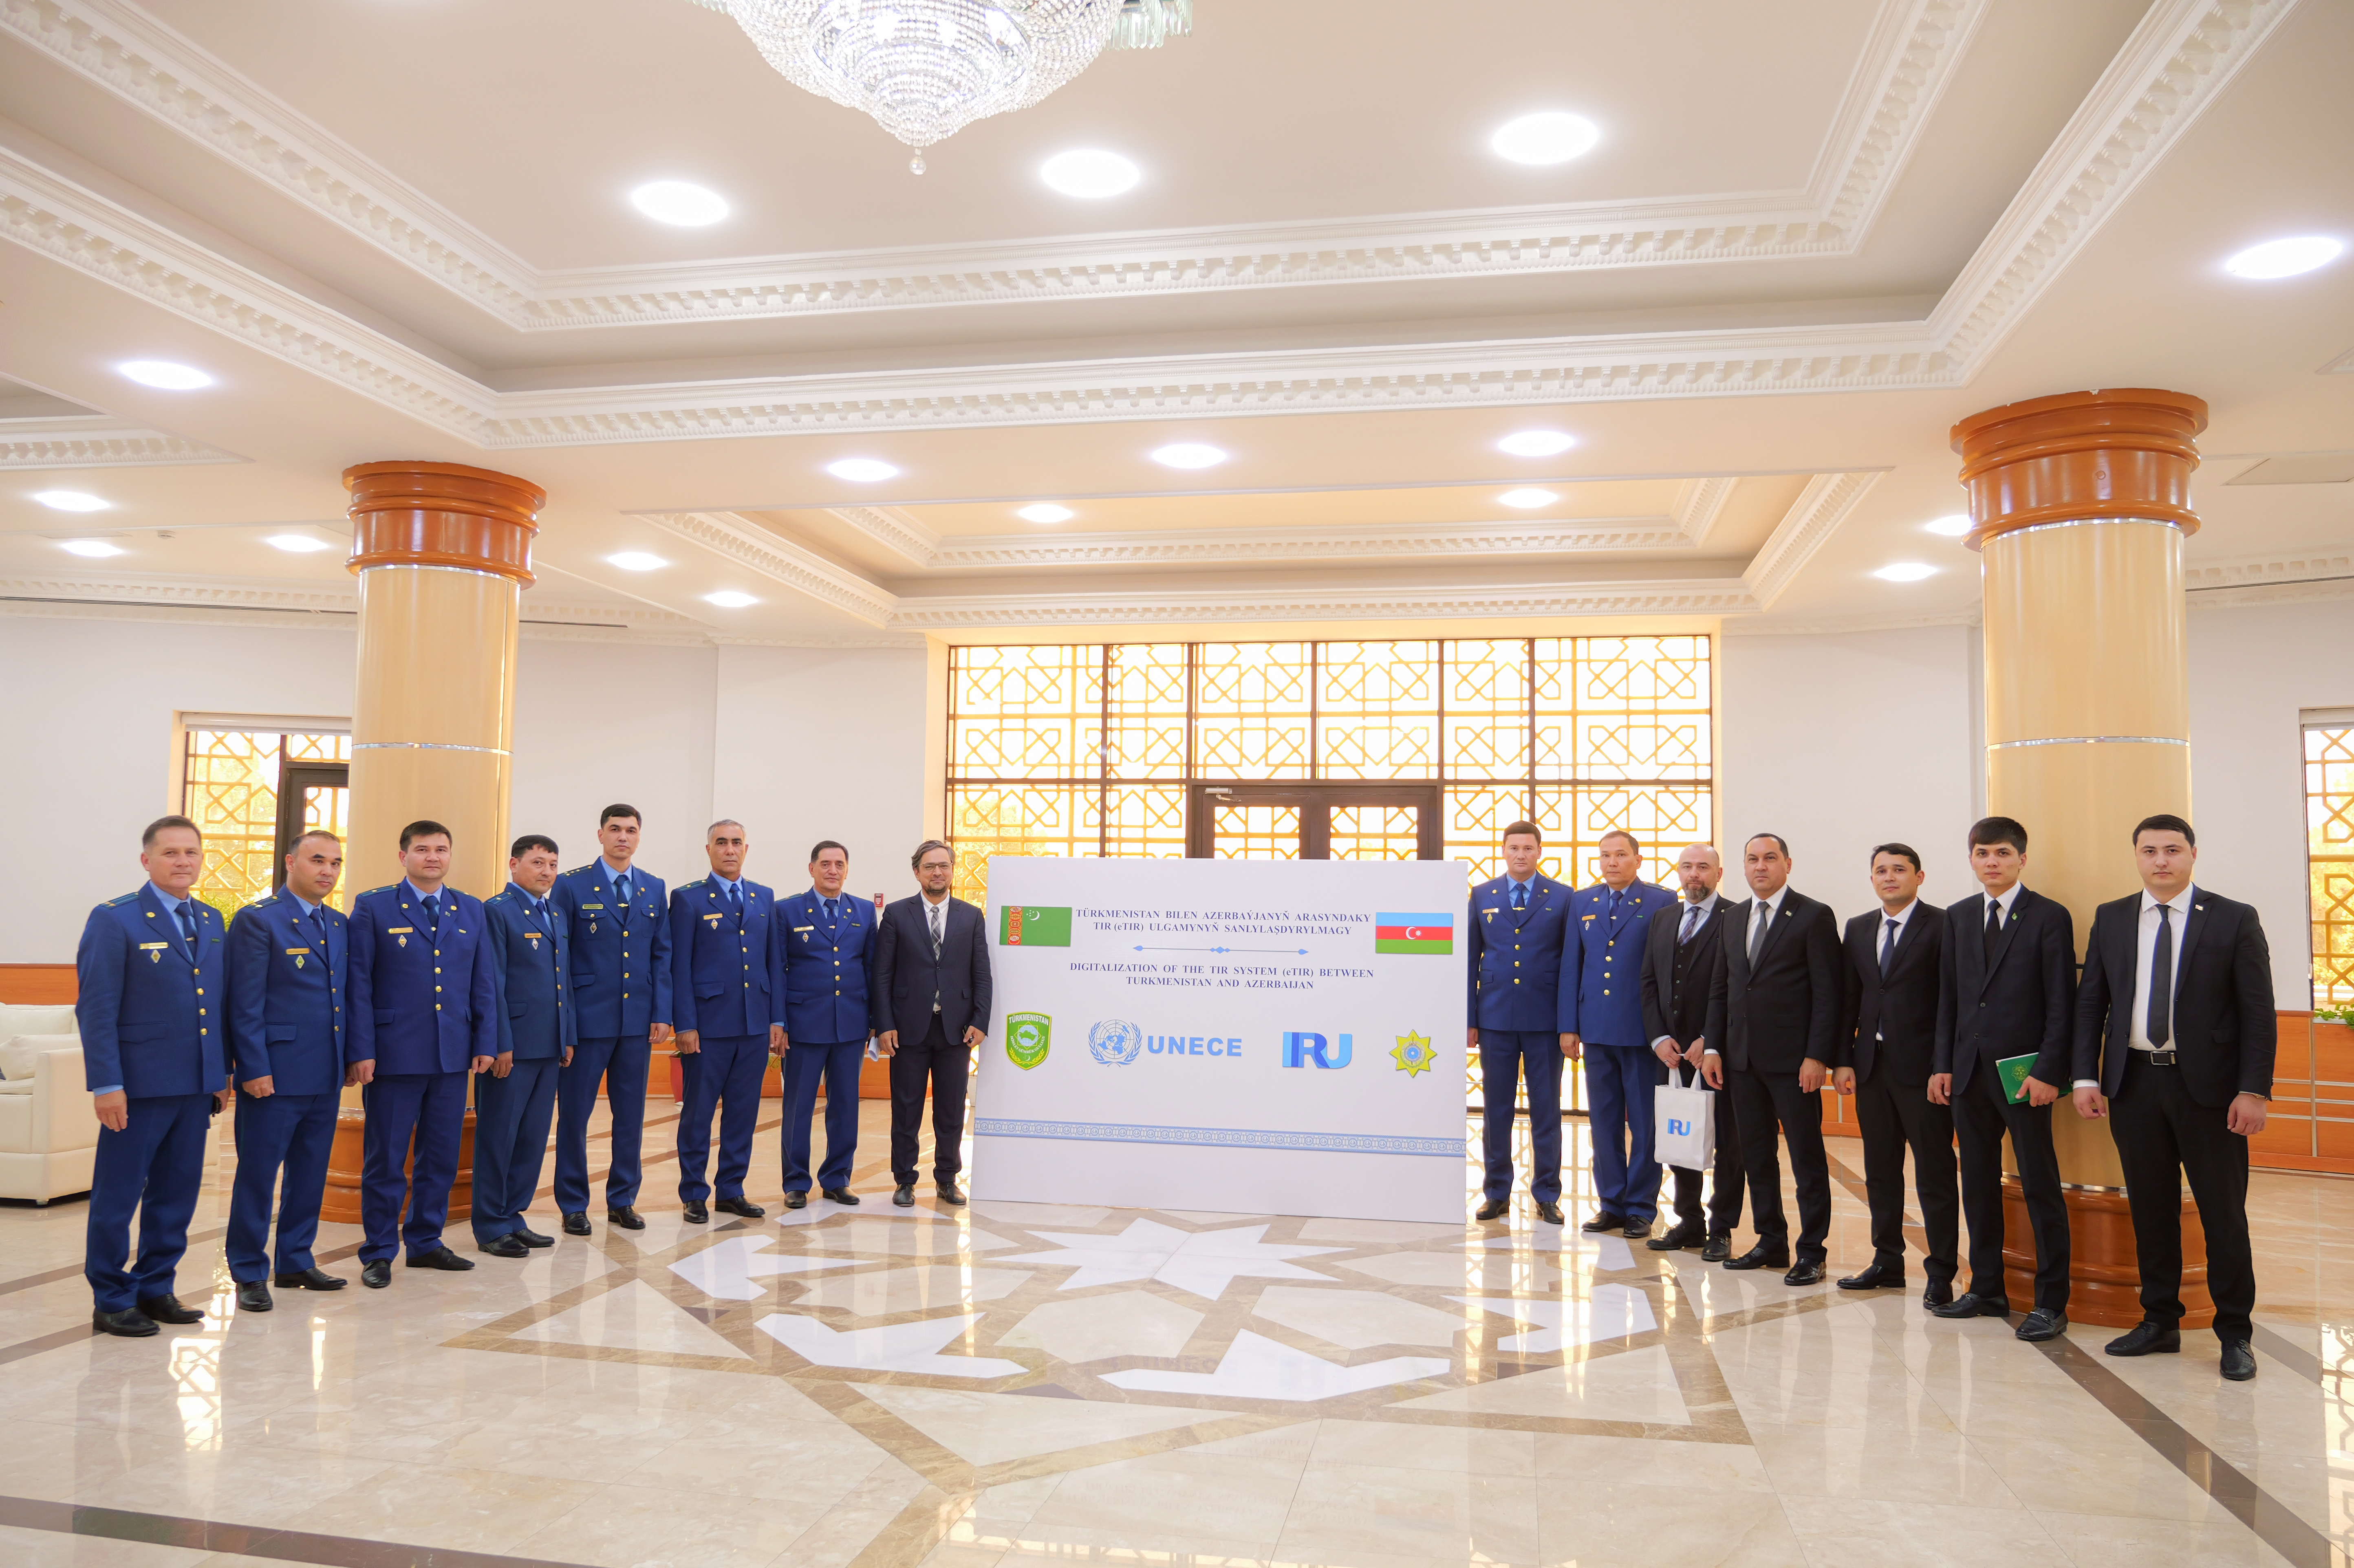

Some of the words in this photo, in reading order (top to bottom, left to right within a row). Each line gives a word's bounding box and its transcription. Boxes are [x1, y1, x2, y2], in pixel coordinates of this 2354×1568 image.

[1076, 907, 1159, 918] TÜRKMENISTAN
[1166, 911, 1197, 919] BILEN
[1202, 910, 1289, 921] AZERBAÝJANYŇ
[1294, 913, 1371, 922] ARASYNDAKY
[1093, 922, 1111, 930] TIR
[1114, 923, 1144, 932] (eTIR)
[1150, 922, 1219, 932] ULGAMYNYŇ
[1224, 924, 1352, 935] SANLYLAŞDYRYLMAGY
[1070, 962, 1157, 972] DIGITALIZATION
[1163, 965, 1178, 973] OF
[1182, 965, 1204, 973] THE
[1209, 966, 1228, 974] TIR
[1233, 966, 1277, 976] SYSTEM
[1283, 967, 1314, 978] (eTIR)
[1319, 968, 1374, 978] BETWEEN
[1126, 976, 1212, 987] TURKMENISTAN
[1217, 979, 1239, 987] AND
[1244, 980, 1314, 989] AZERBAIJAN
[1009, 1014, 1049, 1026] TÜRKMENISTAN
[1148, 1035, 1242, 1057] UNECE
[1282, 1032, 1352, 1069] IRU
[1667, 1118, 1691, 1136] IRU
